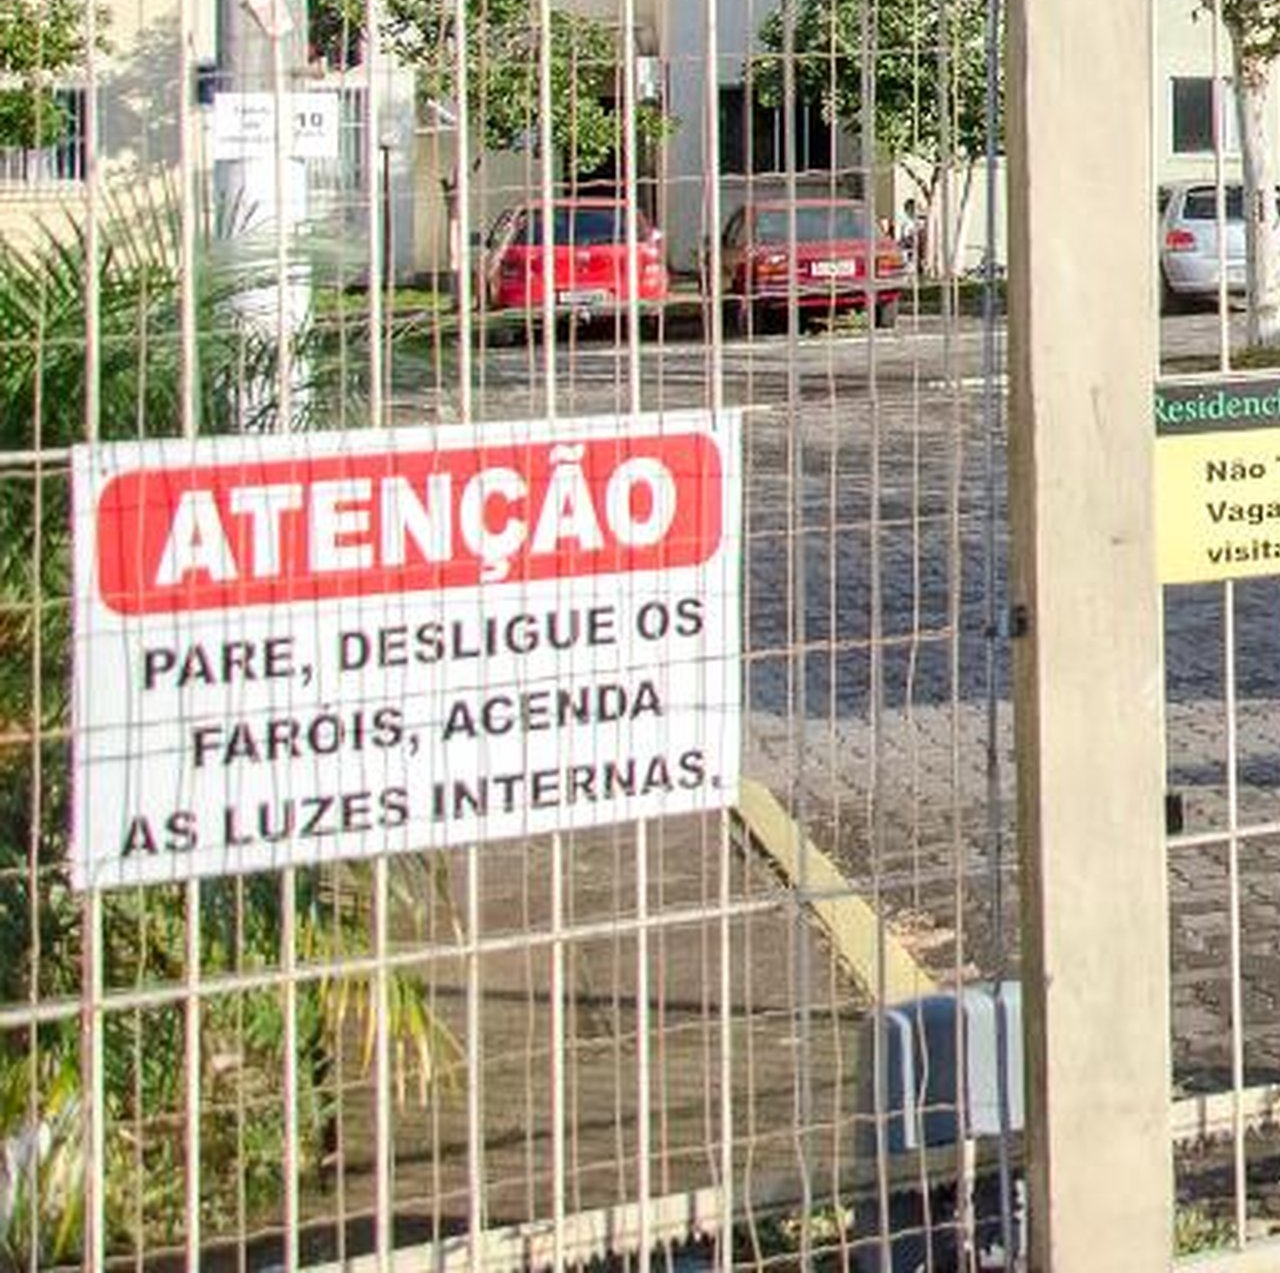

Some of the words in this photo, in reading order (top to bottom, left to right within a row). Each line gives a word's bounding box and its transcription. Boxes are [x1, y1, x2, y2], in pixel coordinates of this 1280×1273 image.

[155, 443, 679, 584] ATENÇÃO
[1206, 458, 1267, 484] Não
[143, 636, 313, 690] PARE,
[338, 604, 617, 674] DESLIGUE
[635, 597, 705, 642] OS
[192, 702, 420, 770] FARÓIS,
[440, 679, 662, 743] ACENDA
[120, 808, 199, 859] AS
[223, 786, 410, 849] LUZES
[430, 749, 724, 822] INTERNAS.
